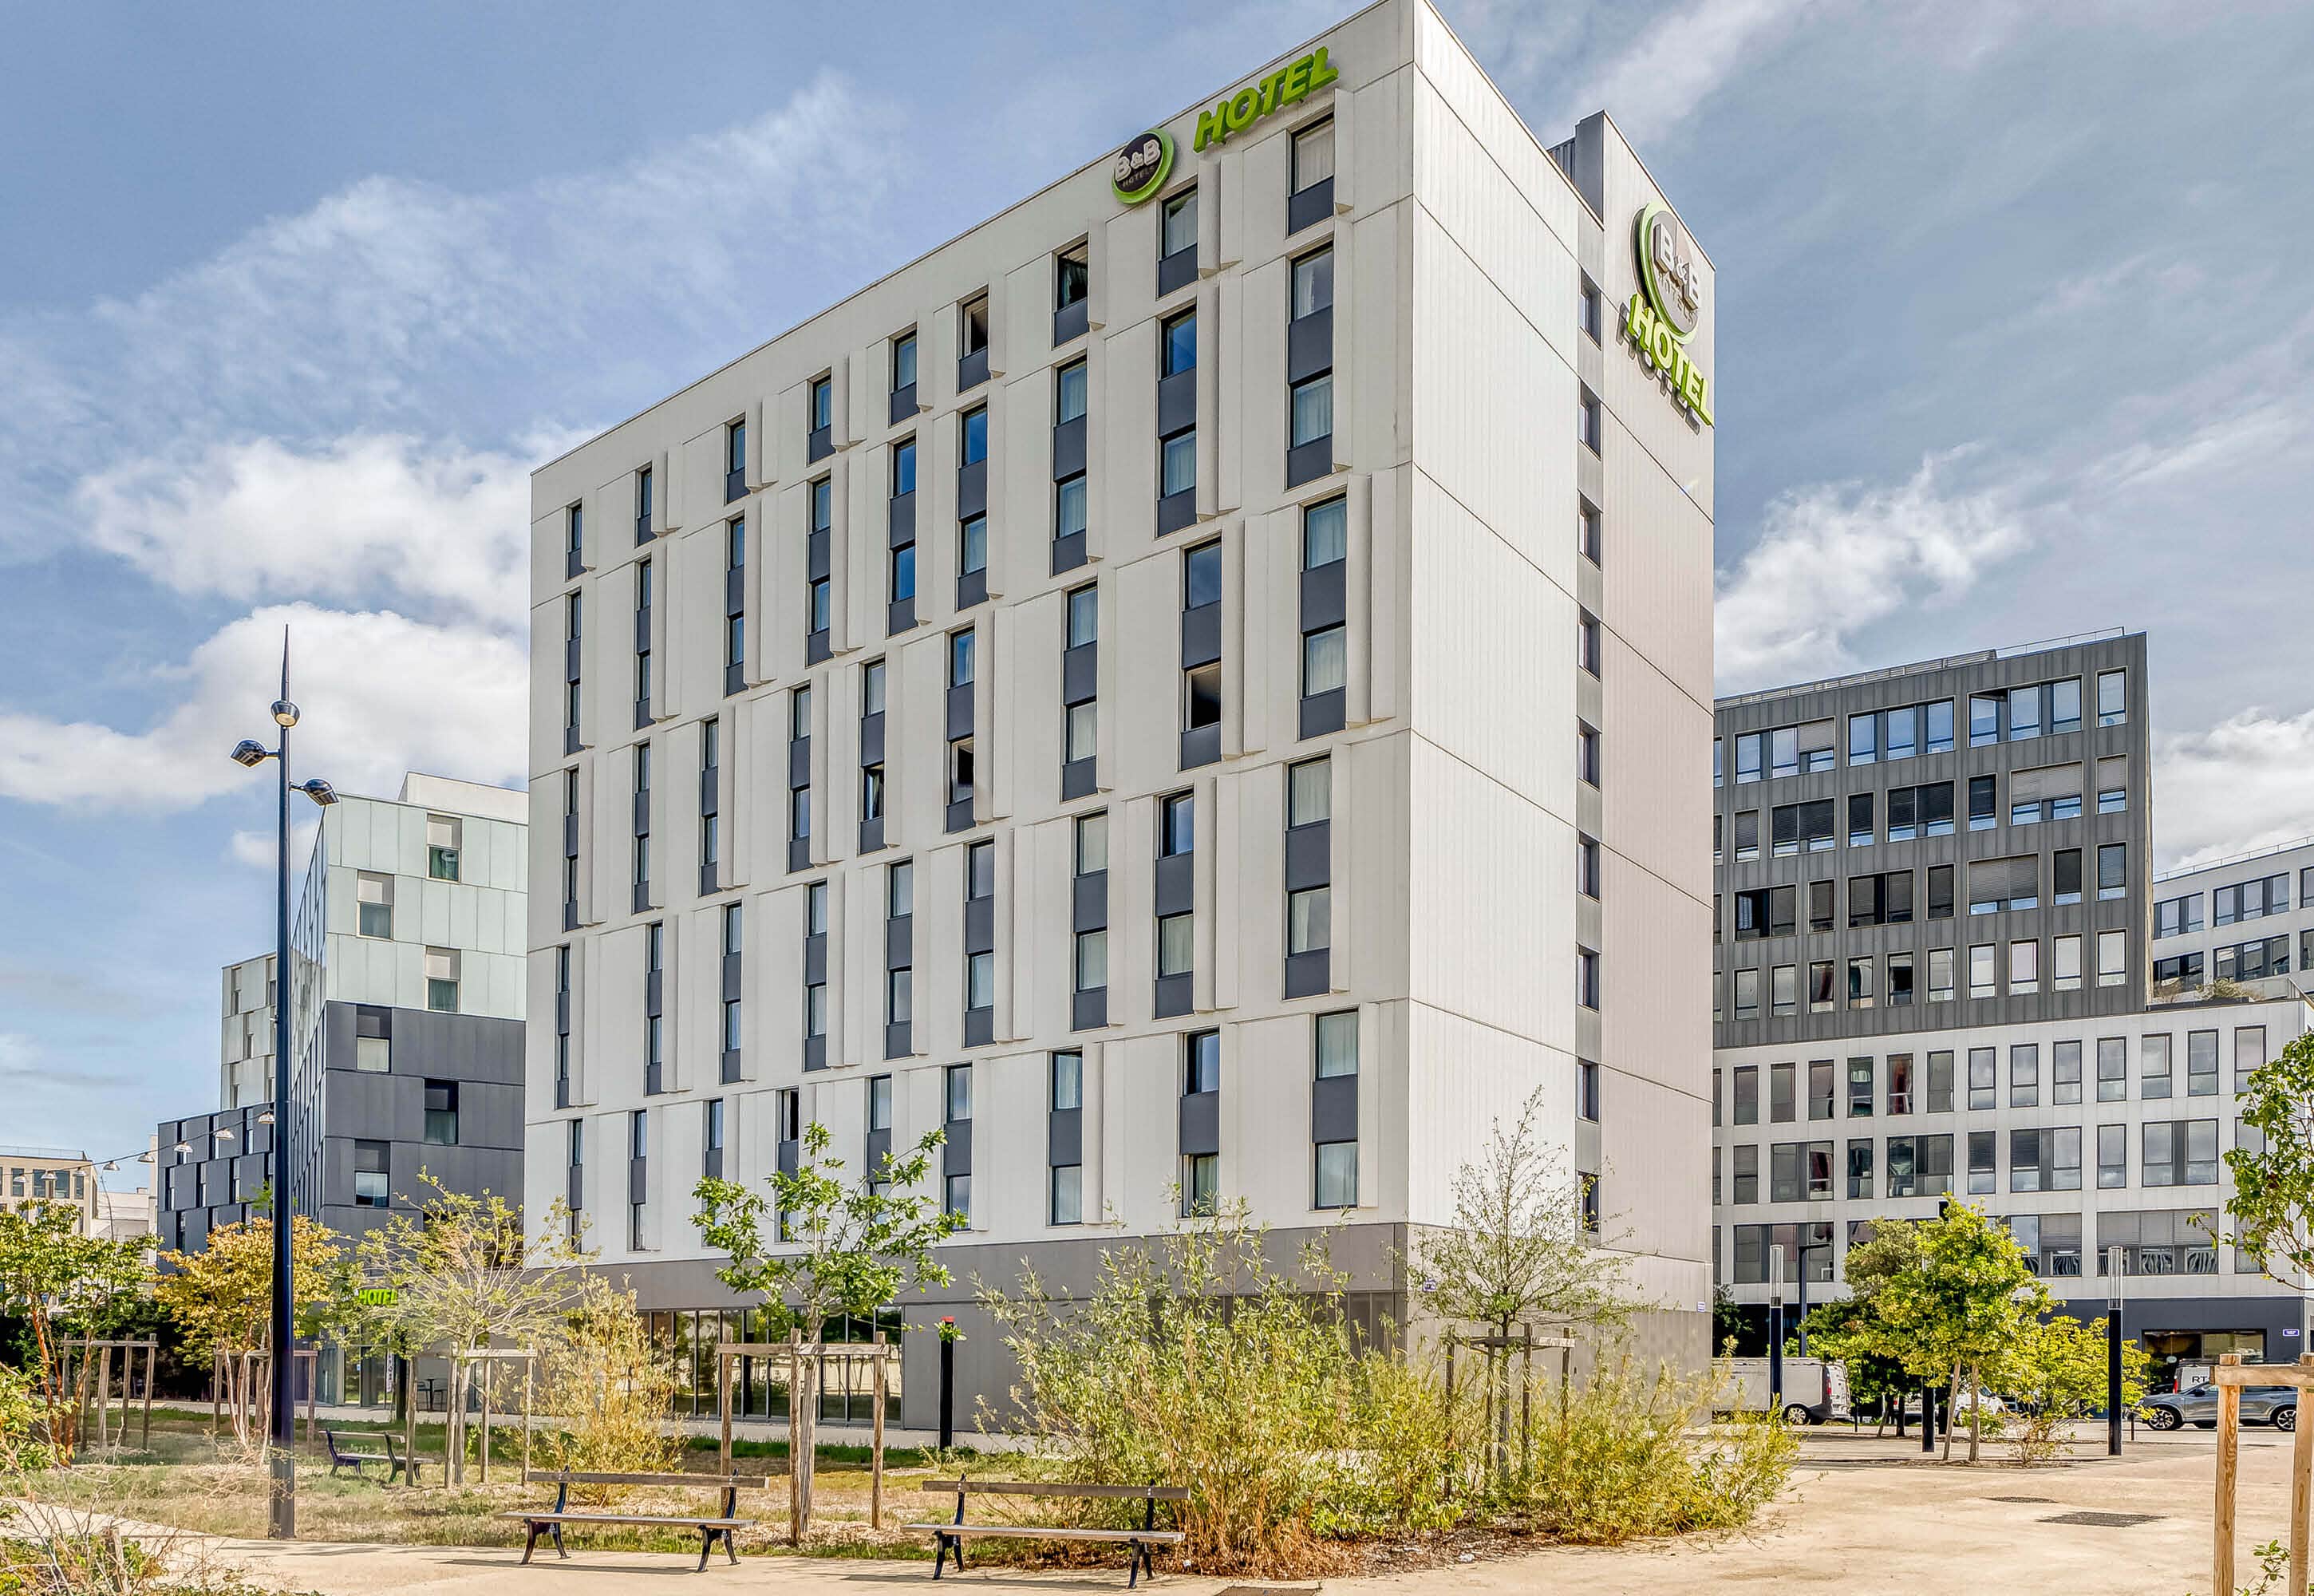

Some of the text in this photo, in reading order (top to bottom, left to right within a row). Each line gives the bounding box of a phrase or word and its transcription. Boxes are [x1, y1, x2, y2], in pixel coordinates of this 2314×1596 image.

[1193, 45, 1340, 153] HOTEL
[1115, 138, 1162, 182] B&B
[1628, 293, 1715, 426] HOTEL
[358, 1289, 398, 1306] HOTEL
